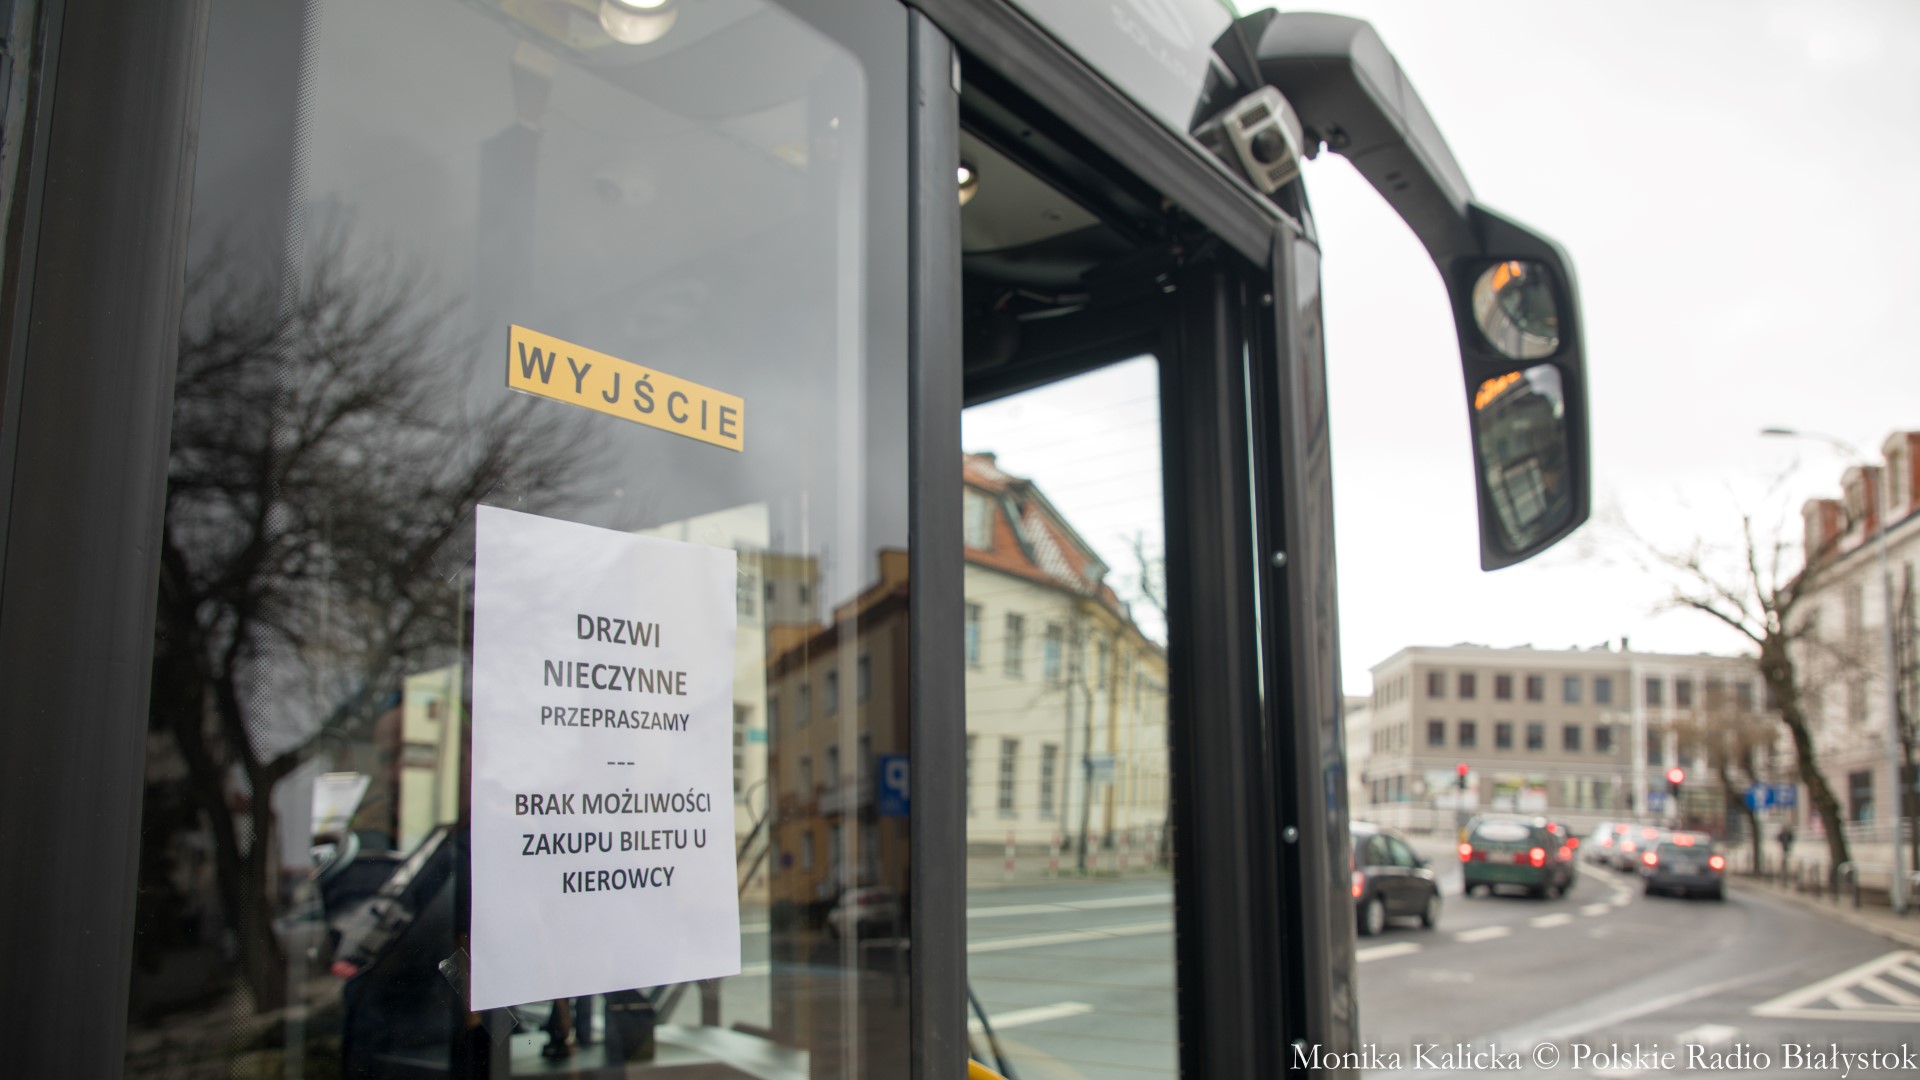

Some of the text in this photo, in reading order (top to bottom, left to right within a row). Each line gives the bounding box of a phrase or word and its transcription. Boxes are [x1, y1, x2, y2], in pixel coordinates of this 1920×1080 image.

[518, 342, 737, 439] WYJŚCIE
[577, 614, 659, 647] DRZWI
[544, 660, 687, 695] NIECZYNNE
[542, 706, 689, 731] PRZEPRASZAMY
[516, 788, 711, 816] BRAK MOŻLIWOŚCI
[522, 829, 706, 856] ZAKUPU BILETU U
[563, 866, 674, 893] KIEROWCY
